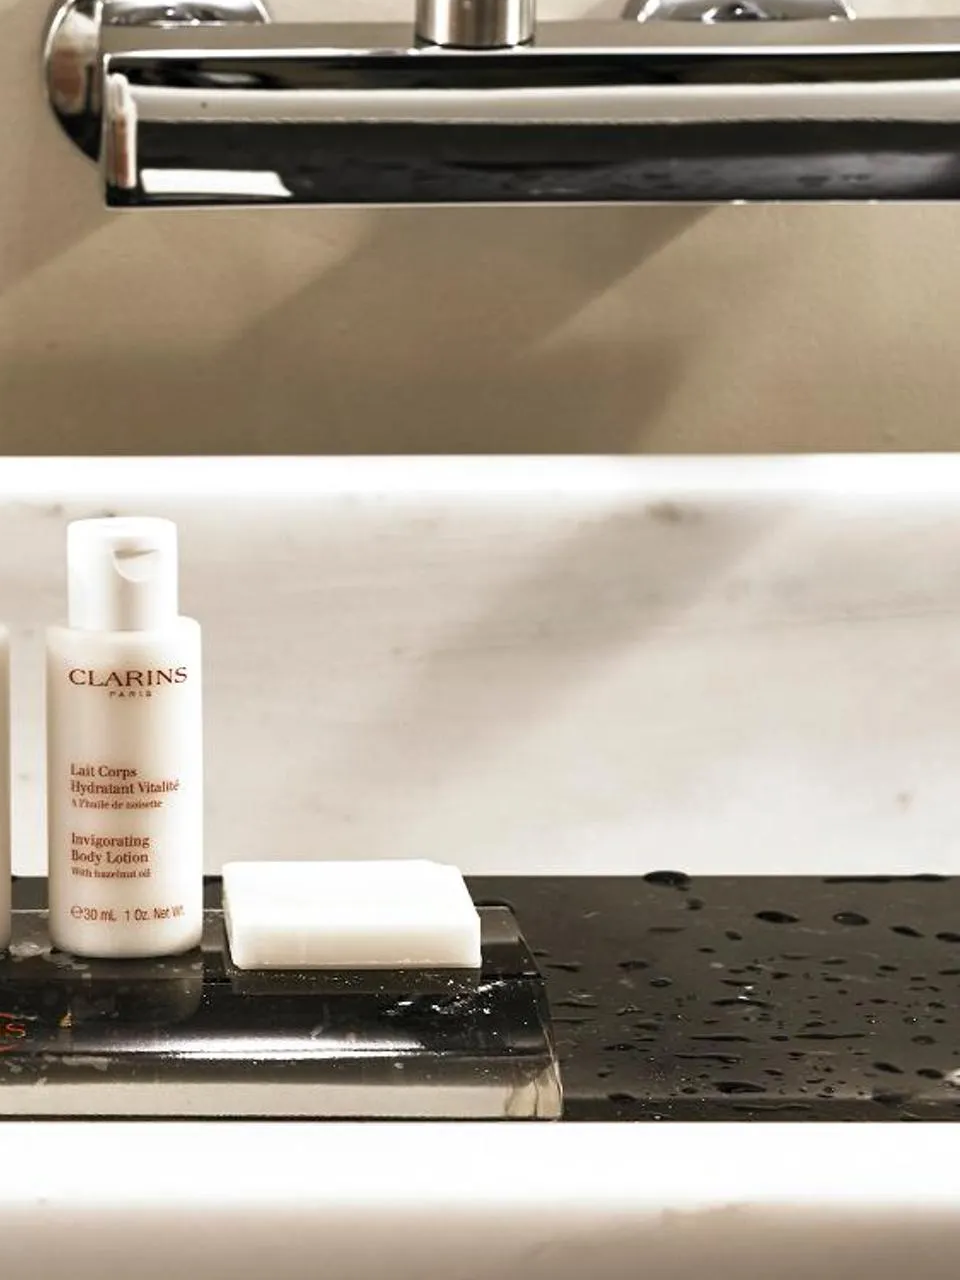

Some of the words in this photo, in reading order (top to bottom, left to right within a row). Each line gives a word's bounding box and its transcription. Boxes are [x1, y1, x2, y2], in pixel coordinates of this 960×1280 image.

[68, 667, 188, 687] CLARINS
[70, 763, 96, 777] Lait
[97, 765, 139, 780] Corps
[70, 780, 135, 796] Hydratant
[138, 779, 181, 794] Vitalité
[71, 832, 150, 849] Invigorating
[71, 849, 102, 865] Body
[106, 851, 149, 864] Lotion
[94, 869, 136, 879] hazelnut
[138, 868, 150, 878] oil
[124, 910, 129, 922] 1
